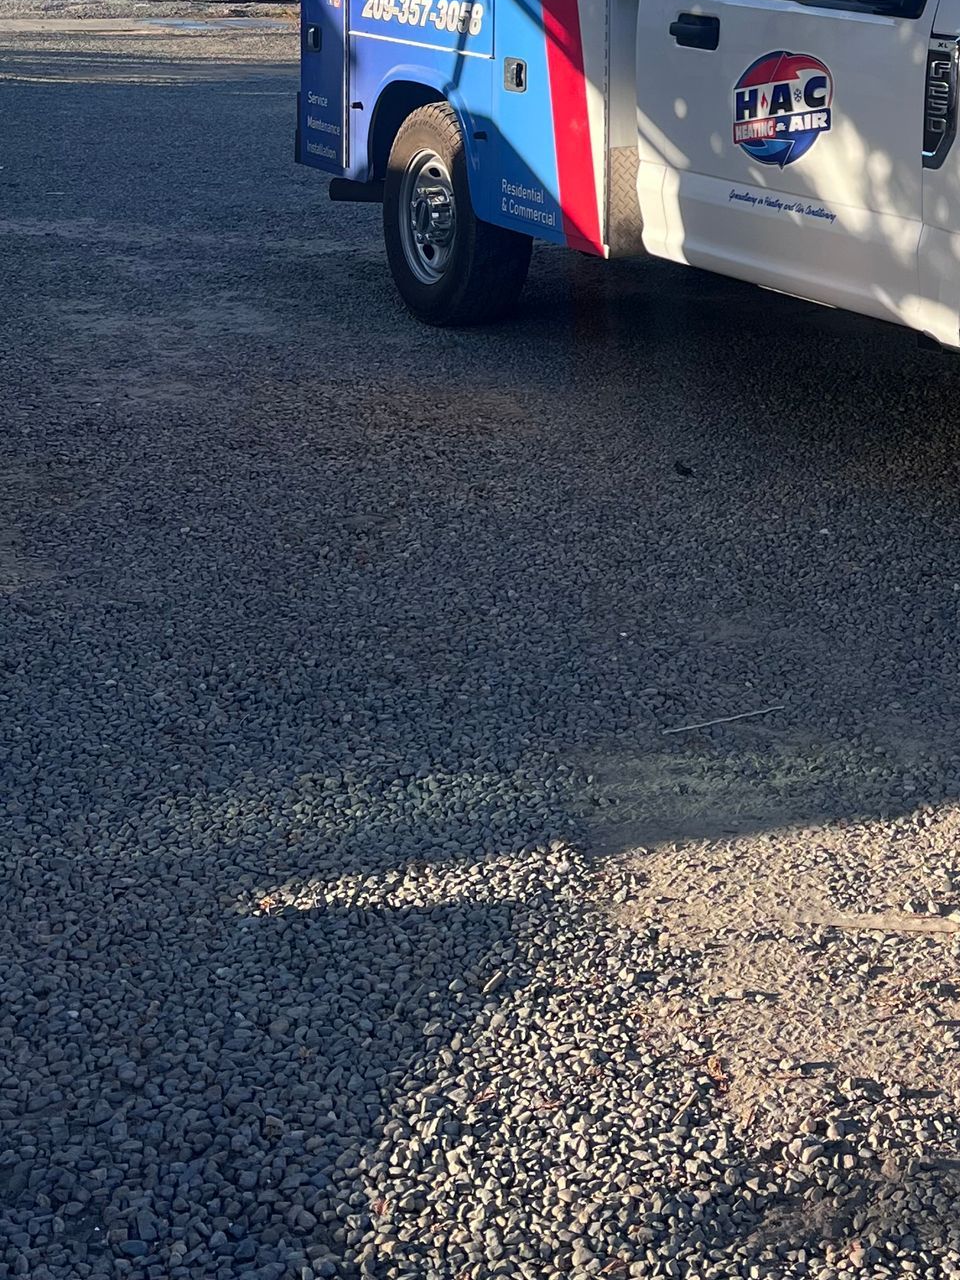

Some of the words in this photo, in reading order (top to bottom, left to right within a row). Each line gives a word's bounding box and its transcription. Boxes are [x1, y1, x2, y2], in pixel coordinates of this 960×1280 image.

[937, 41, 949, 49] XL
[307, 90, 328, 108] Service
[307, 115, 341, 136] Maintenance
[736, 120, 774, 141] HEATING
[776, 122, 787, 132] &
[788, 112, 828, 133] AIR
[307, 140, 337, 159] Installation
[501, 178, 544, 204] Residential
[501, 197, 508, 212] &
[509, 199, 556, 227] Commercial
